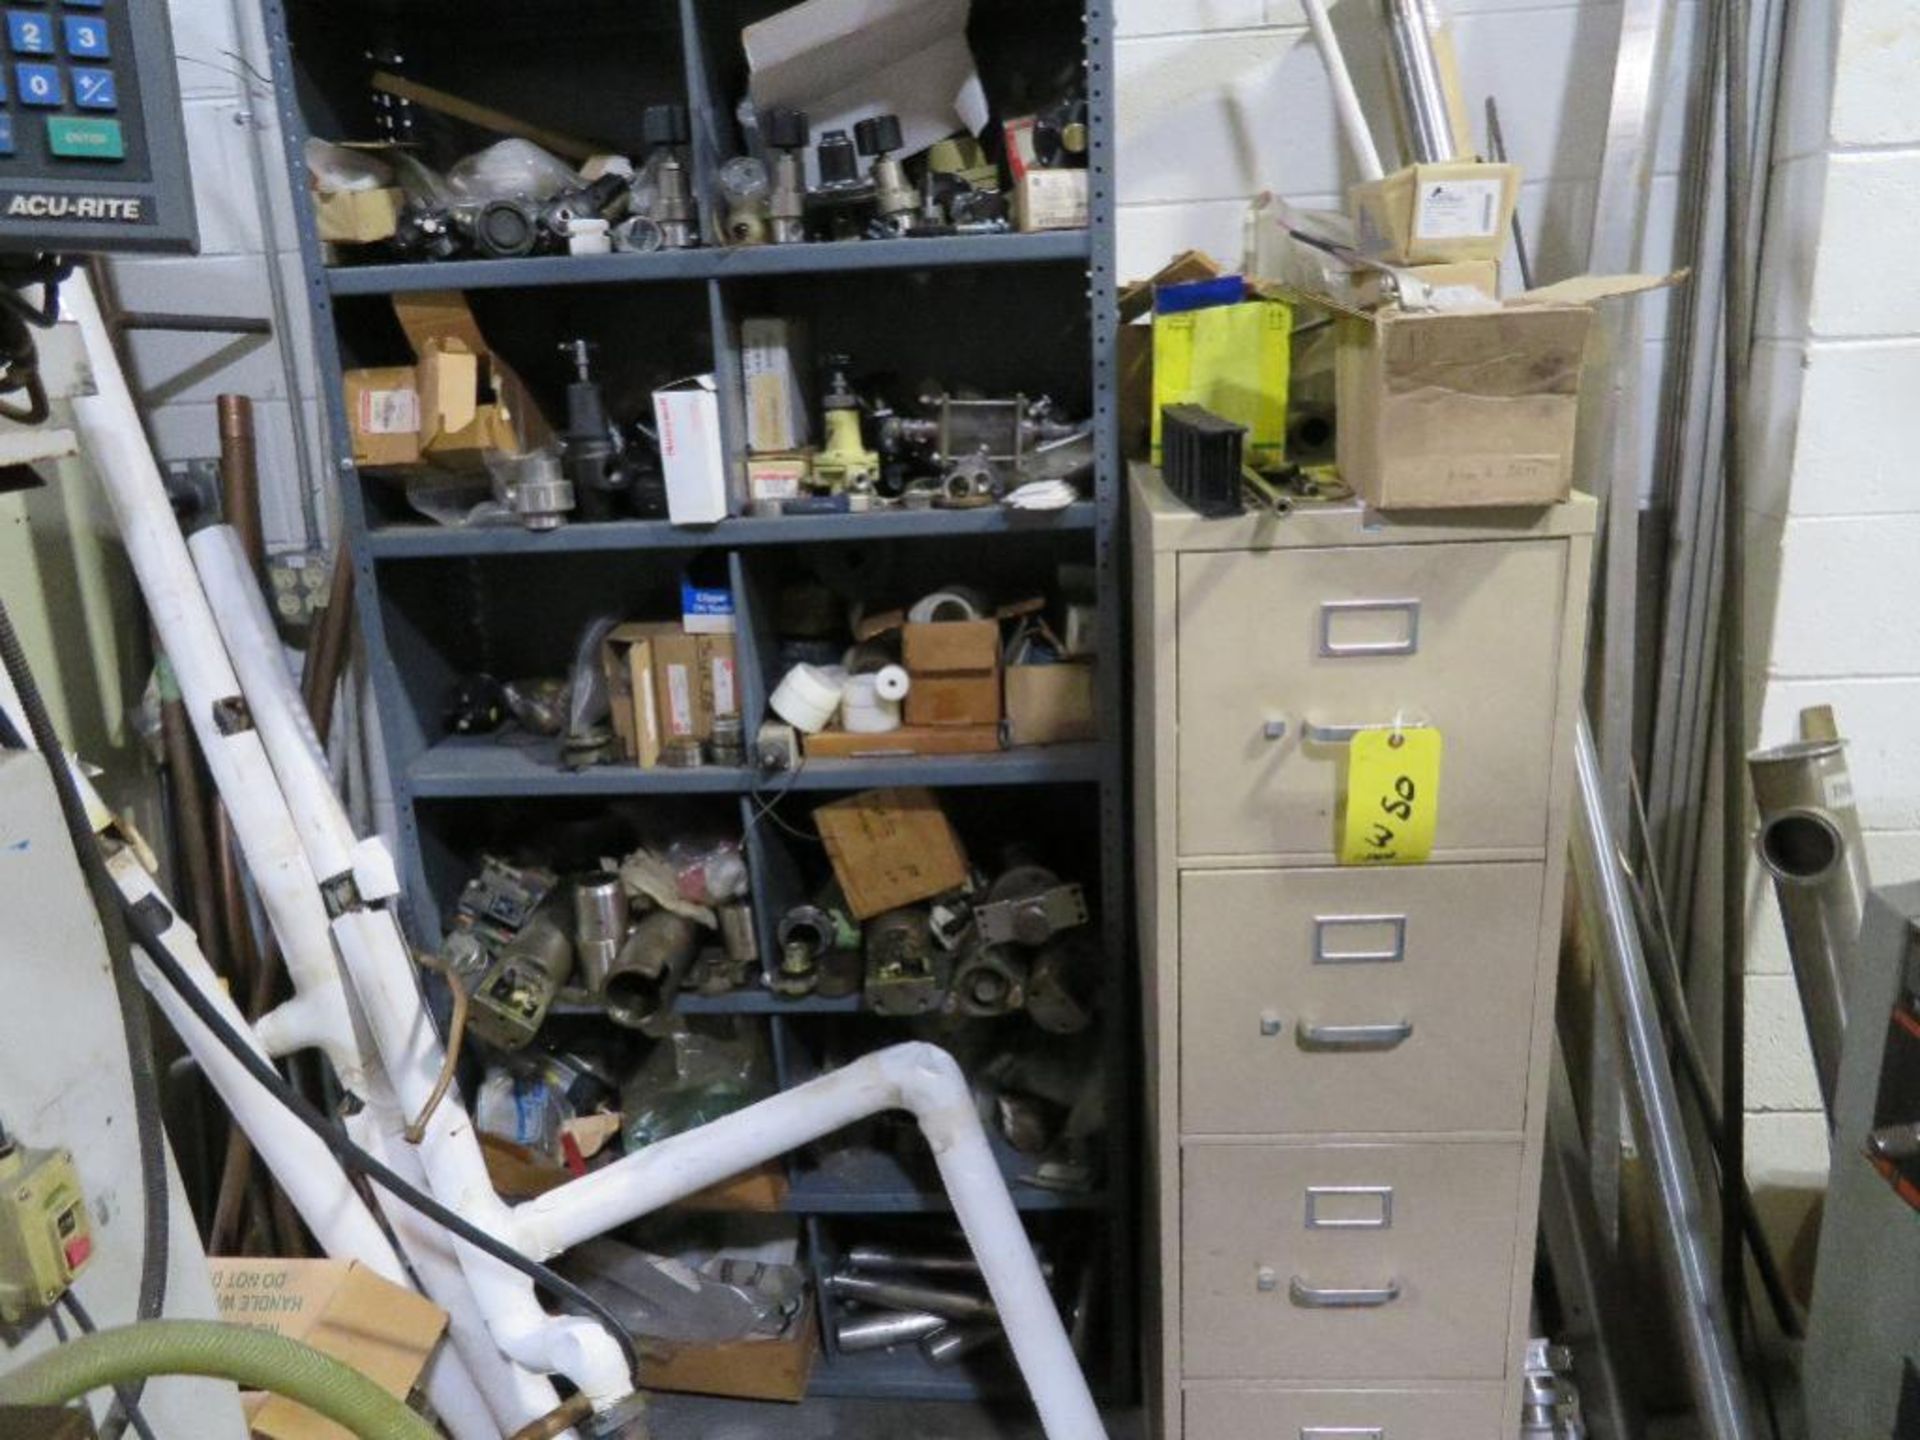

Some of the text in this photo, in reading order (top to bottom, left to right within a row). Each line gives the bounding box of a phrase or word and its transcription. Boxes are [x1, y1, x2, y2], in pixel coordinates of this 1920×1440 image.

[21, 22, 42, 45] 2
[79, 26, 96, 48] 3
[8, 194, 141, 219] ACU-RITE
[239, 1293, 303, 1313] HANDLE
